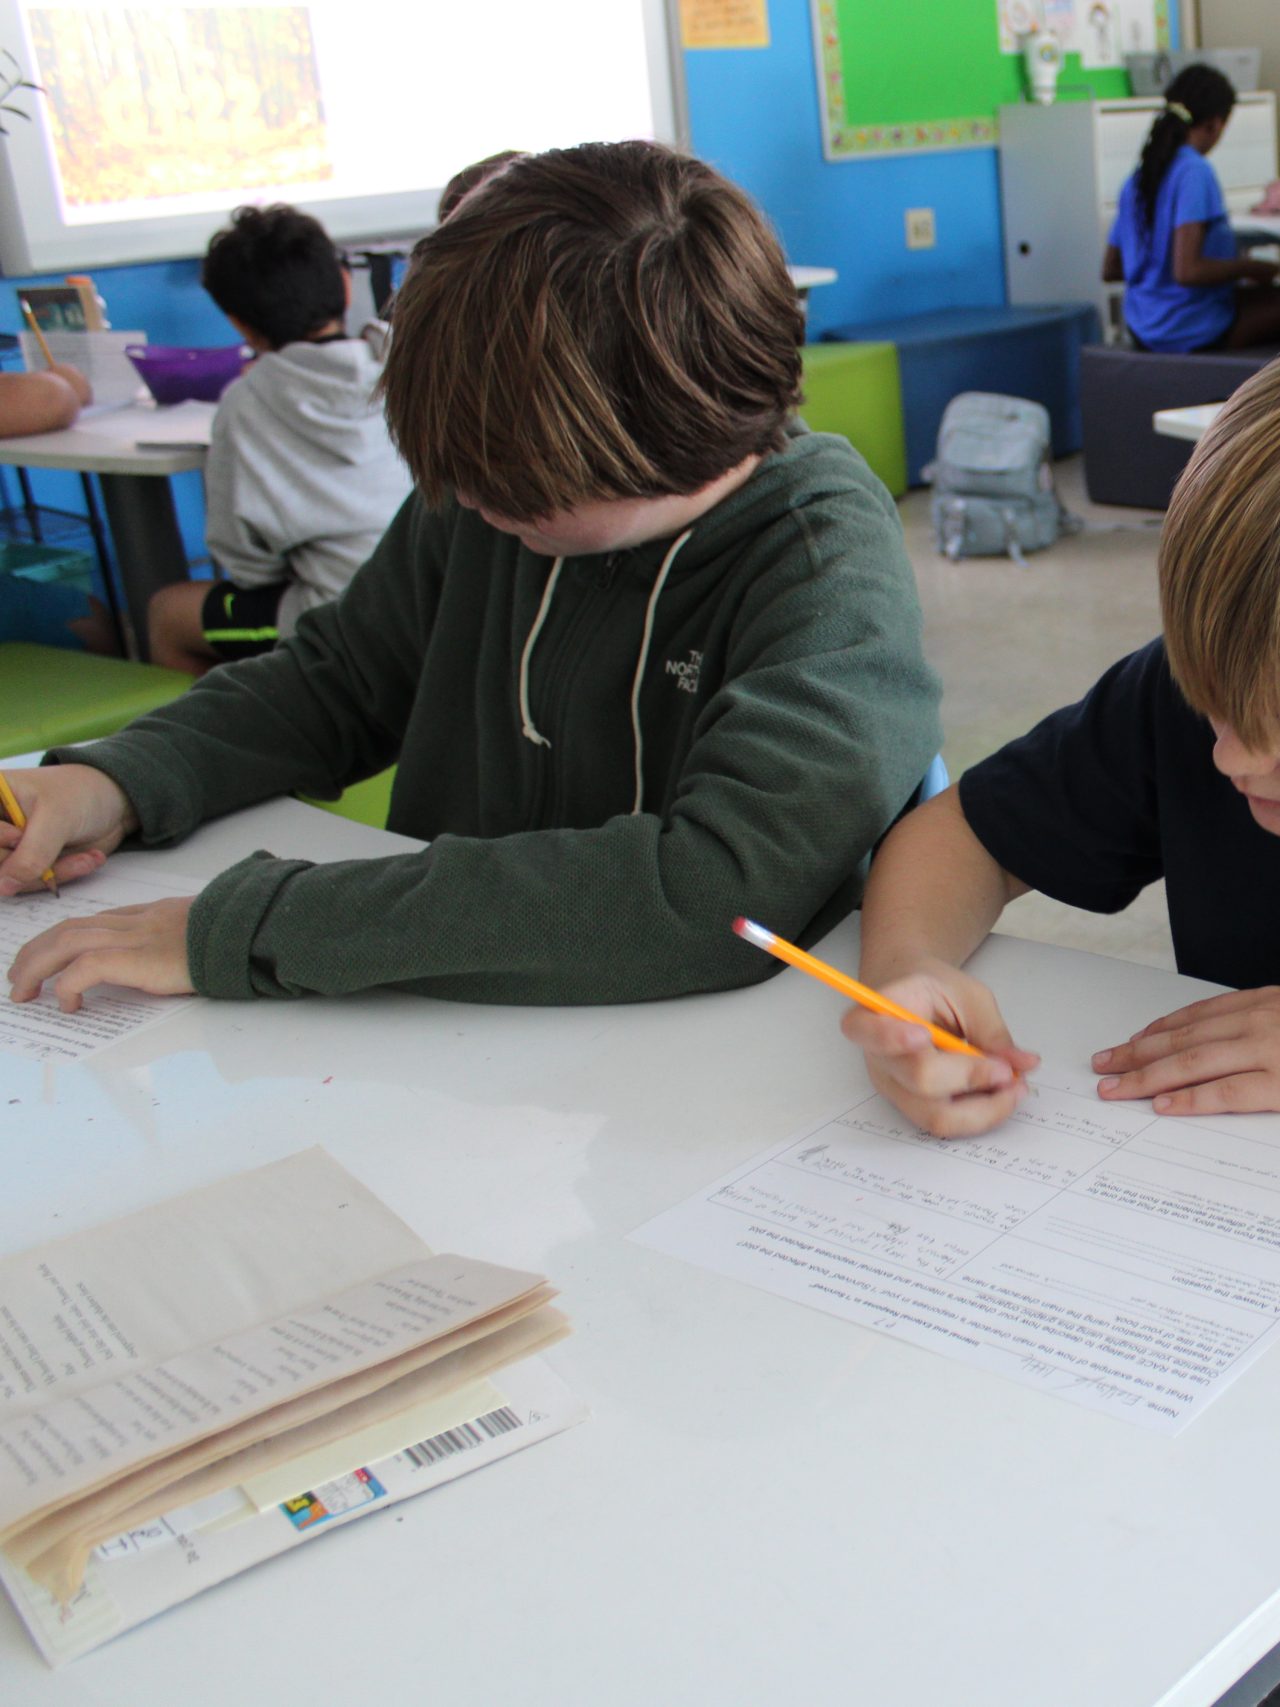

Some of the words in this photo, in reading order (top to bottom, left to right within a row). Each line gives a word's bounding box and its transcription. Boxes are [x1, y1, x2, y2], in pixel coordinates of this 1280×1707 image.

[665, 660, 701, 676] NOR
[1100, 1190, 1118, 1199] one
[1117, 1196, 1137, 1205] and
[1123, 1190, 1139, 1198] the
[1139, 1194, 1160, 1204] from
[1136, 1201, 1157, 1211] Plot
[1161, 1200, 1208, 1217] sentences
[1170, 1211, 1190, 1220] one
[1208, 1214, 1247, 1228] different
[765, 1231, 781, 1240] the
[1216, 1225, 1233, 1233] the
[1233, 1229, 1256, 1240] from
[779, 1236, 815, 1251] affected
[759, 1247, 775, 1256] the
[814, 1248, 858, 1266] responses
[772, 1252, 808, 1267] affected
[808, 1264, 830, 1276] book
[857, 1263, 894, 1278] external
[892, 1275, 913, 1285] and
[962, 1275, 989, 1288] name
[1171, 1276, 1213, 1291] question
[880, 1290, 902, 1300] your
[910, 1282, 946, 1296] internal
[989, 1284, 1041, 1304] character's
[947, 1293, 997, 1314] character's
[1041, 1302, 1065, 1313] main
[1232, 1294, 1268, 1309] Answer
[912, 1300, 959, 1320] responses
[997, 1311, 1020, 1322] your
[1020, 1308, 1058, 1323] graphic
[960, 1317, 1012, 1338] character's
[1021, 1318, 1041, 1330] how
[1057, 1319, 1076, 1331] this
[1083, 1314, 1111, 1328] using
[932, 1325, 949, 1334] and
[1042, 1326, 1084, 1343] describe
[1076, 1325, 1104, 1340] using
[1111, 1325, 1154, 1342] question
[1140, 1324, 1164, 1336] your
[948, 1332, 980, 1347] Internal
[1012, 1336, 1037, 1348] main
[1104, 1336, 1147, 1355] thoughts
[1176, 1336, 1195, 1347] title
[1037, 1344, 1055, 1355] the
[1055, 1350, 1077, 1362] how
[1096, 1344, 1136, 1361] strategy
[1173, 1345, 1212, 1362] Restate
[1213, 1348, 1235, 1359] and
[1148, 1351, 1173, 1362] your
[1089, 1362, 1133, 1380] example
[1139, 1358, 1169, 1373] RACE
[1173, 1358, 1219, 1378] Organize
[1133, 1377, 1155, 1388] one
[1189, 1374, 1211, 1386] Use
[1165, 1388, 1194, 1403] What
